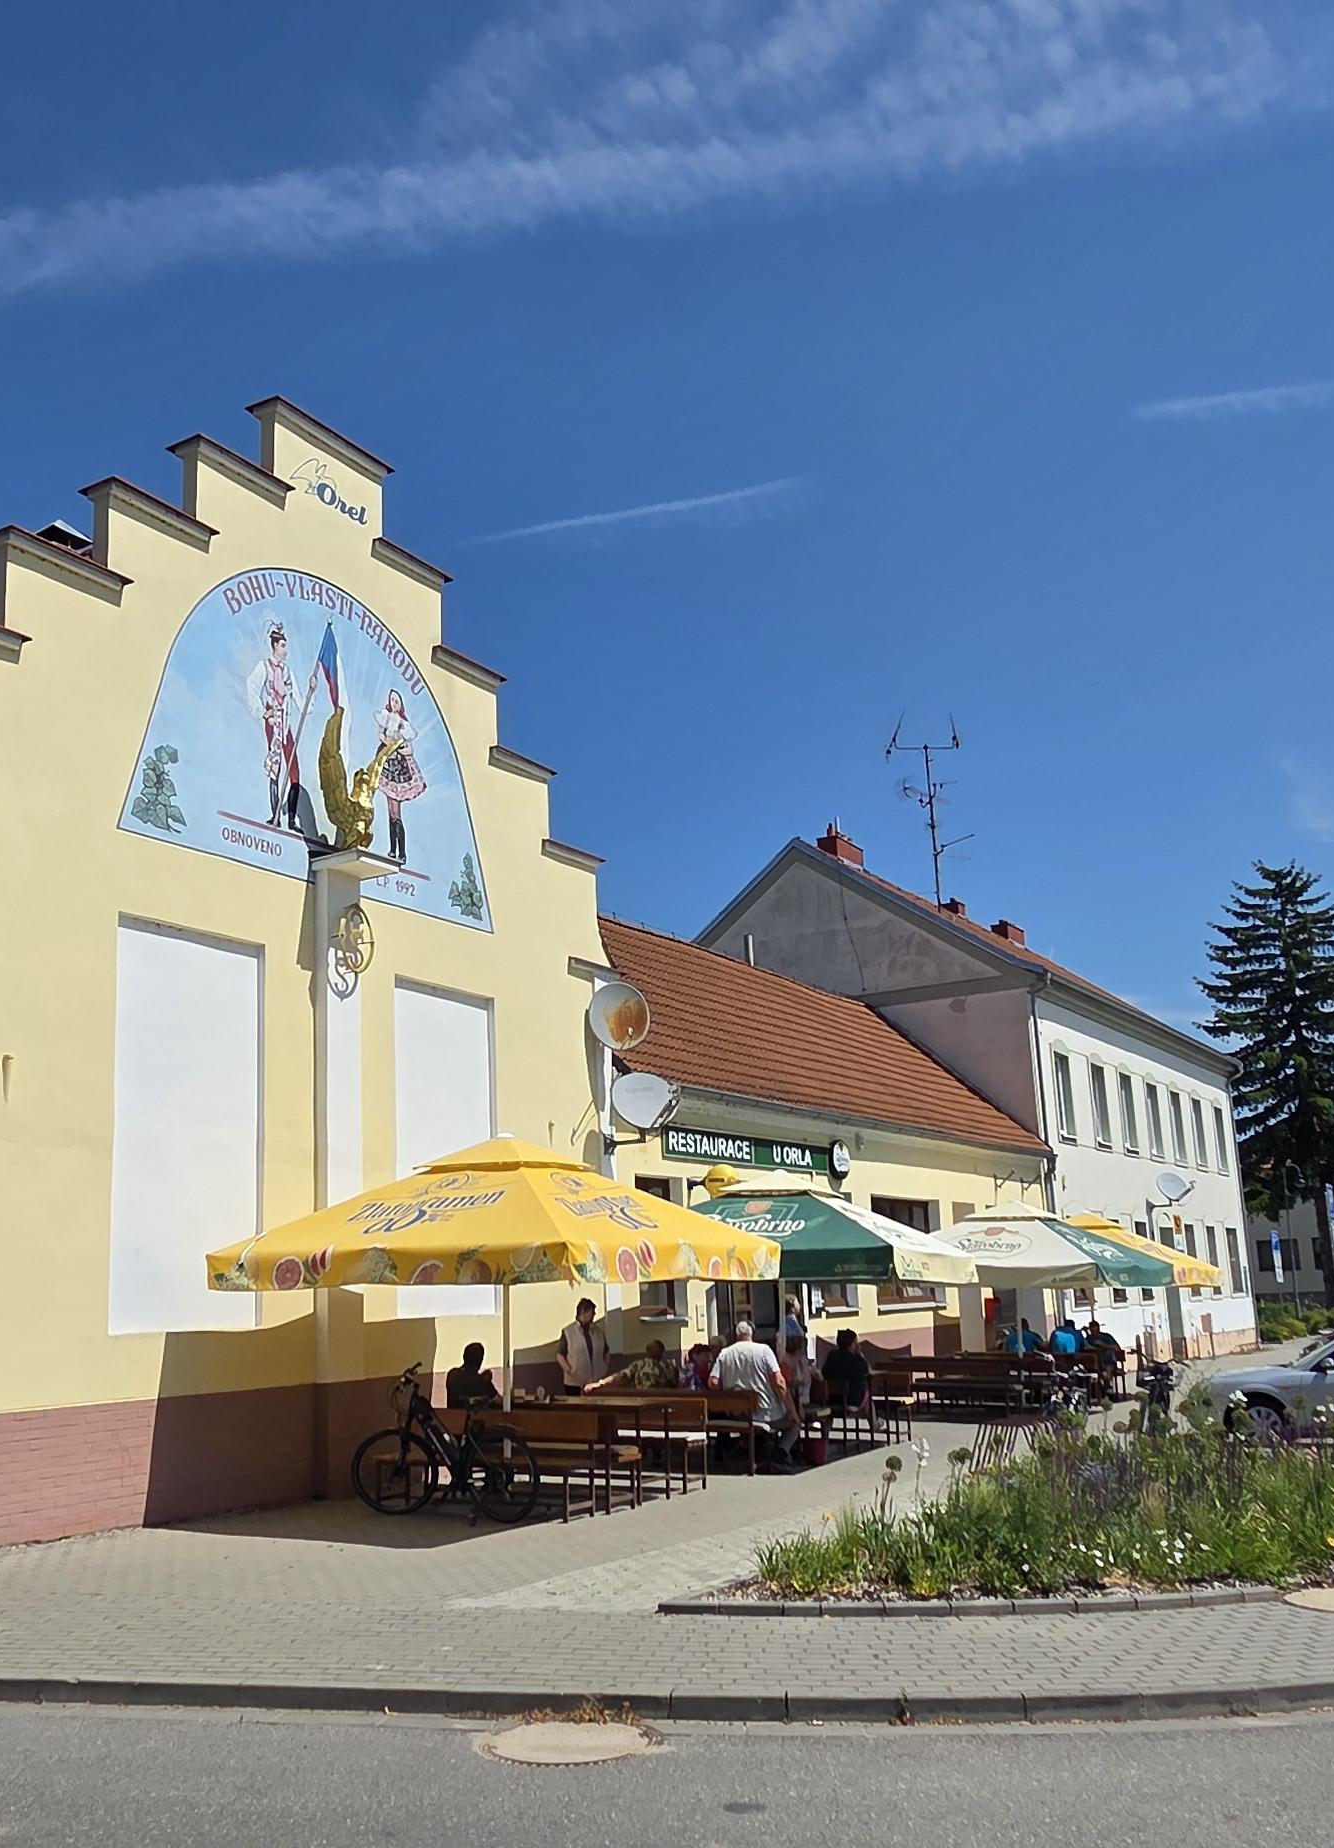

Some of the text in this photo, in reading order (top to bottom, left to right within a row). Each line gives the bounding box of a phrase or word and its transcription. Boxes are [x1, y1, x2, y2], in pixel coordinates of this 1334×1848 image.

[316, 482, 368, 525] Orel
[221, 826, 283, 858] OBNOVENO
[668, 1130, 751, 1160] RESTAURACE
[772, 1144, 782, 1164] U
[782, 1146, 813, 1167] ORLA
